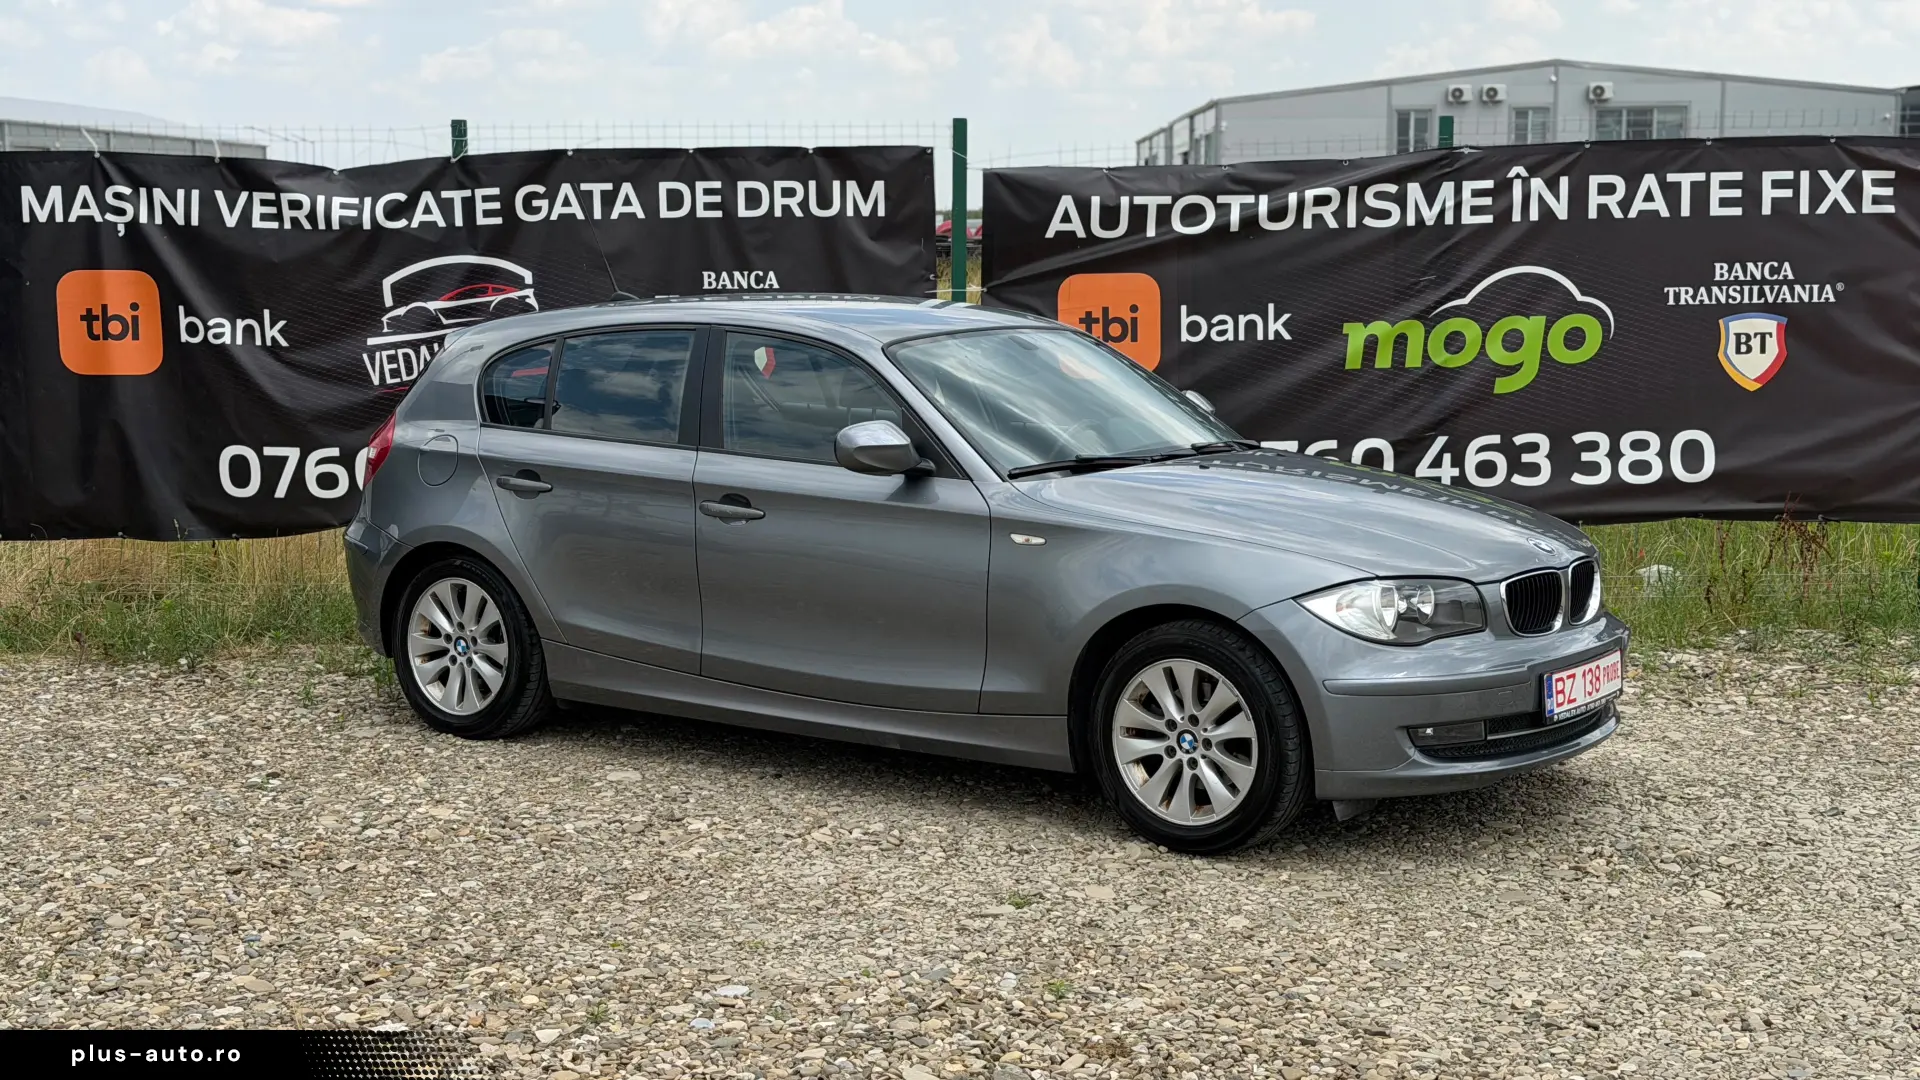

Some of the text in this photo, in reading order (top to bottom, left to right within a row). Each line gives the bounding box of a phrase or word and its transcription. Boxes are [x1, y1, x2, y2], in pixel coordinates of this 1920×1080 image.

[20, 179, 886, 237] MAȘINI VERIFICATE GATA DE DRUM
[1045, 165, 1896, 239] AUTOTURISME ÎN RATE FIXE
[701, 270, 780, 290] BANCA
[1713, 261, 1795, 281] BANCA
[79, 301, 290, 347] tbi bank
[1078, 302, 1294, 344] tbi bank
[1733, 331, 1773, 355] BT
[362, 343, 439, 386] VEDA
[1342, 312, 1603, 394] mogo
[1415, 432, 1552, 489] 463
[1570, 429, 1716, 486] 380
[1555, 660, 1620, 708] BZ 138 PROBE
